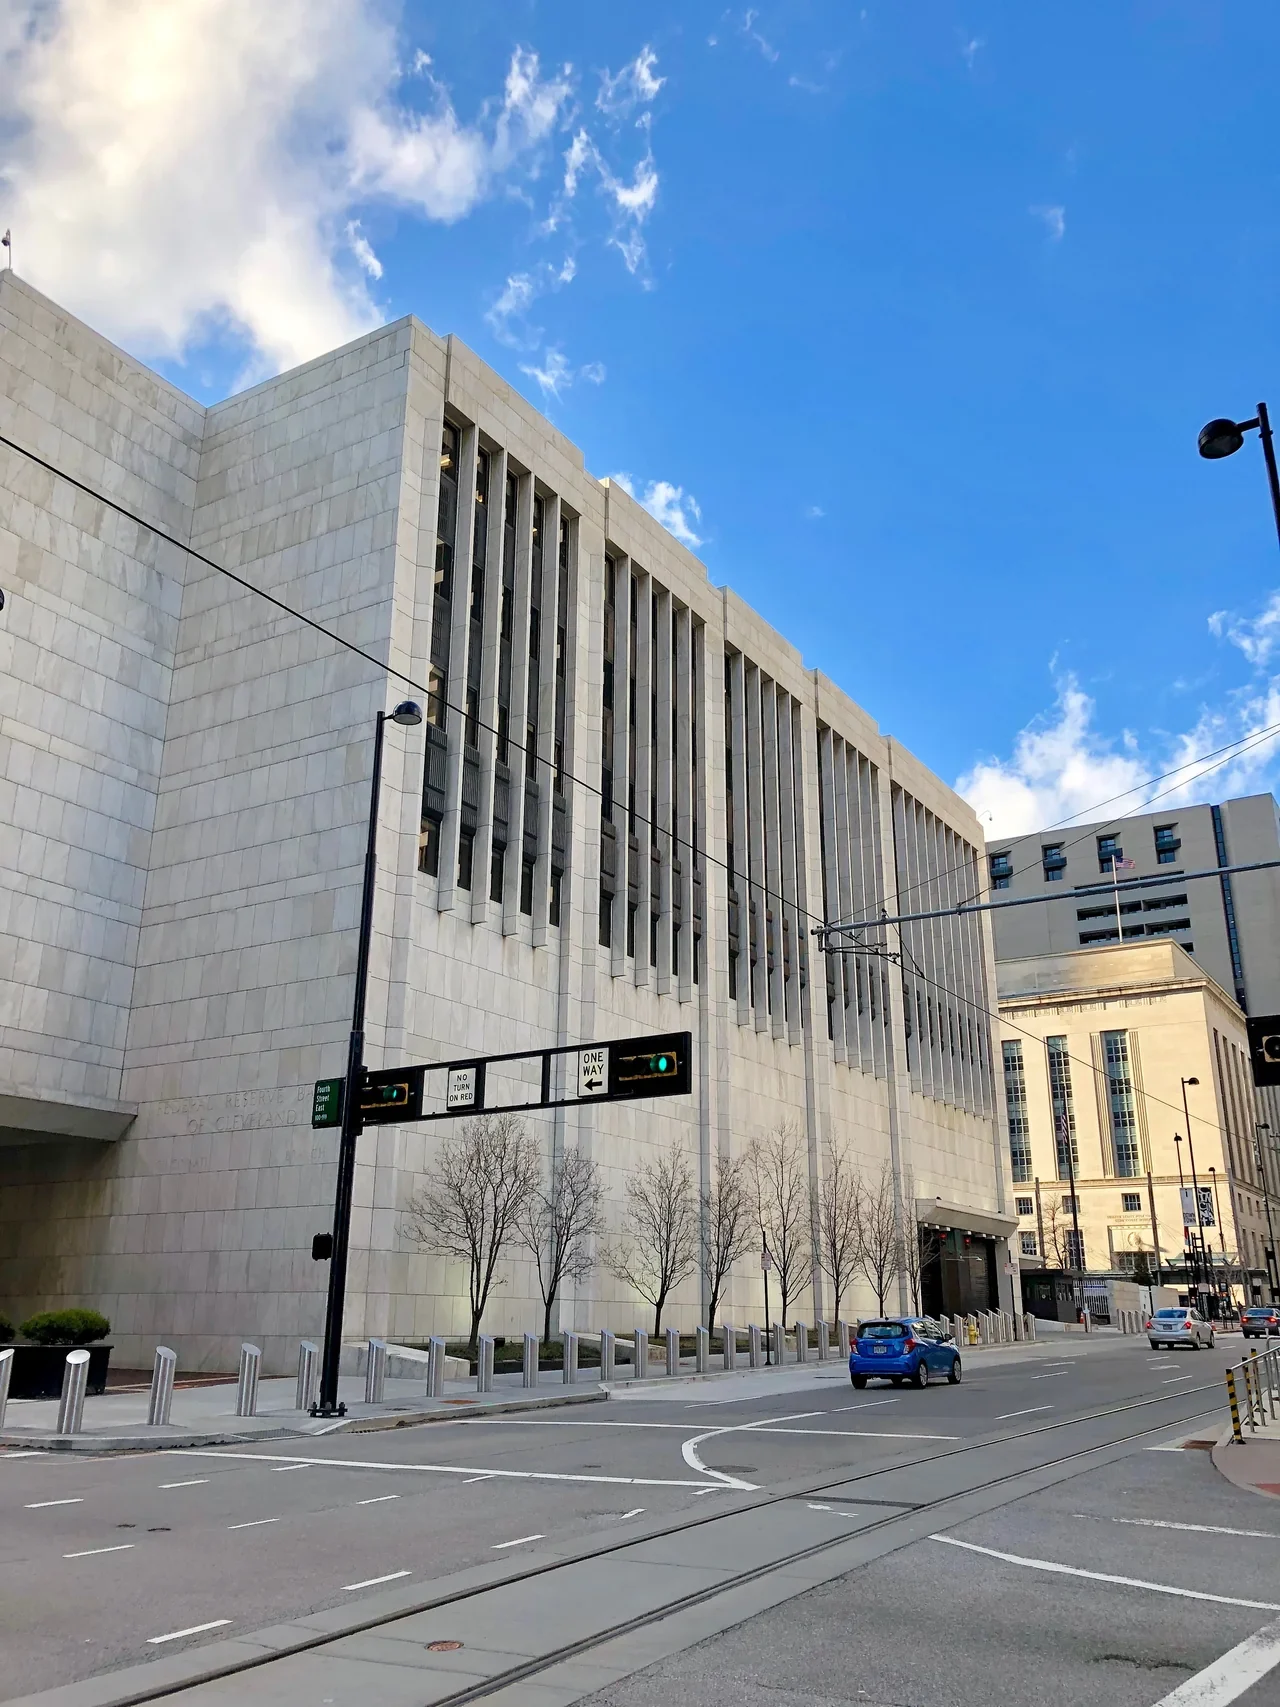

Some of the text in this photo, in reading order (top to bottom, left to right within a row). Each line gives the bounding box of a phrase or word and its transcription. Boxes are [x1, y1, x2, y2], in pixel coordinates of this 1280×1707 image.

[583, 1051, 604, 1064] ONE
[582, 1063, 605, 1077] WAY
[456, 1073, 468, 1082] NO
[317, 1084, 331, 1094] Fourth
[453, 1083, 470, 1092] TURN
[225, 1088, 285, 1109] RESERVE
[316, 1094, 330, 1103] Street
[449, 1092, 473, 1102] ON RED
[315, 1104, 325, 1112] East
[188, 1109, 297, 1134] OF CLEVELAND
